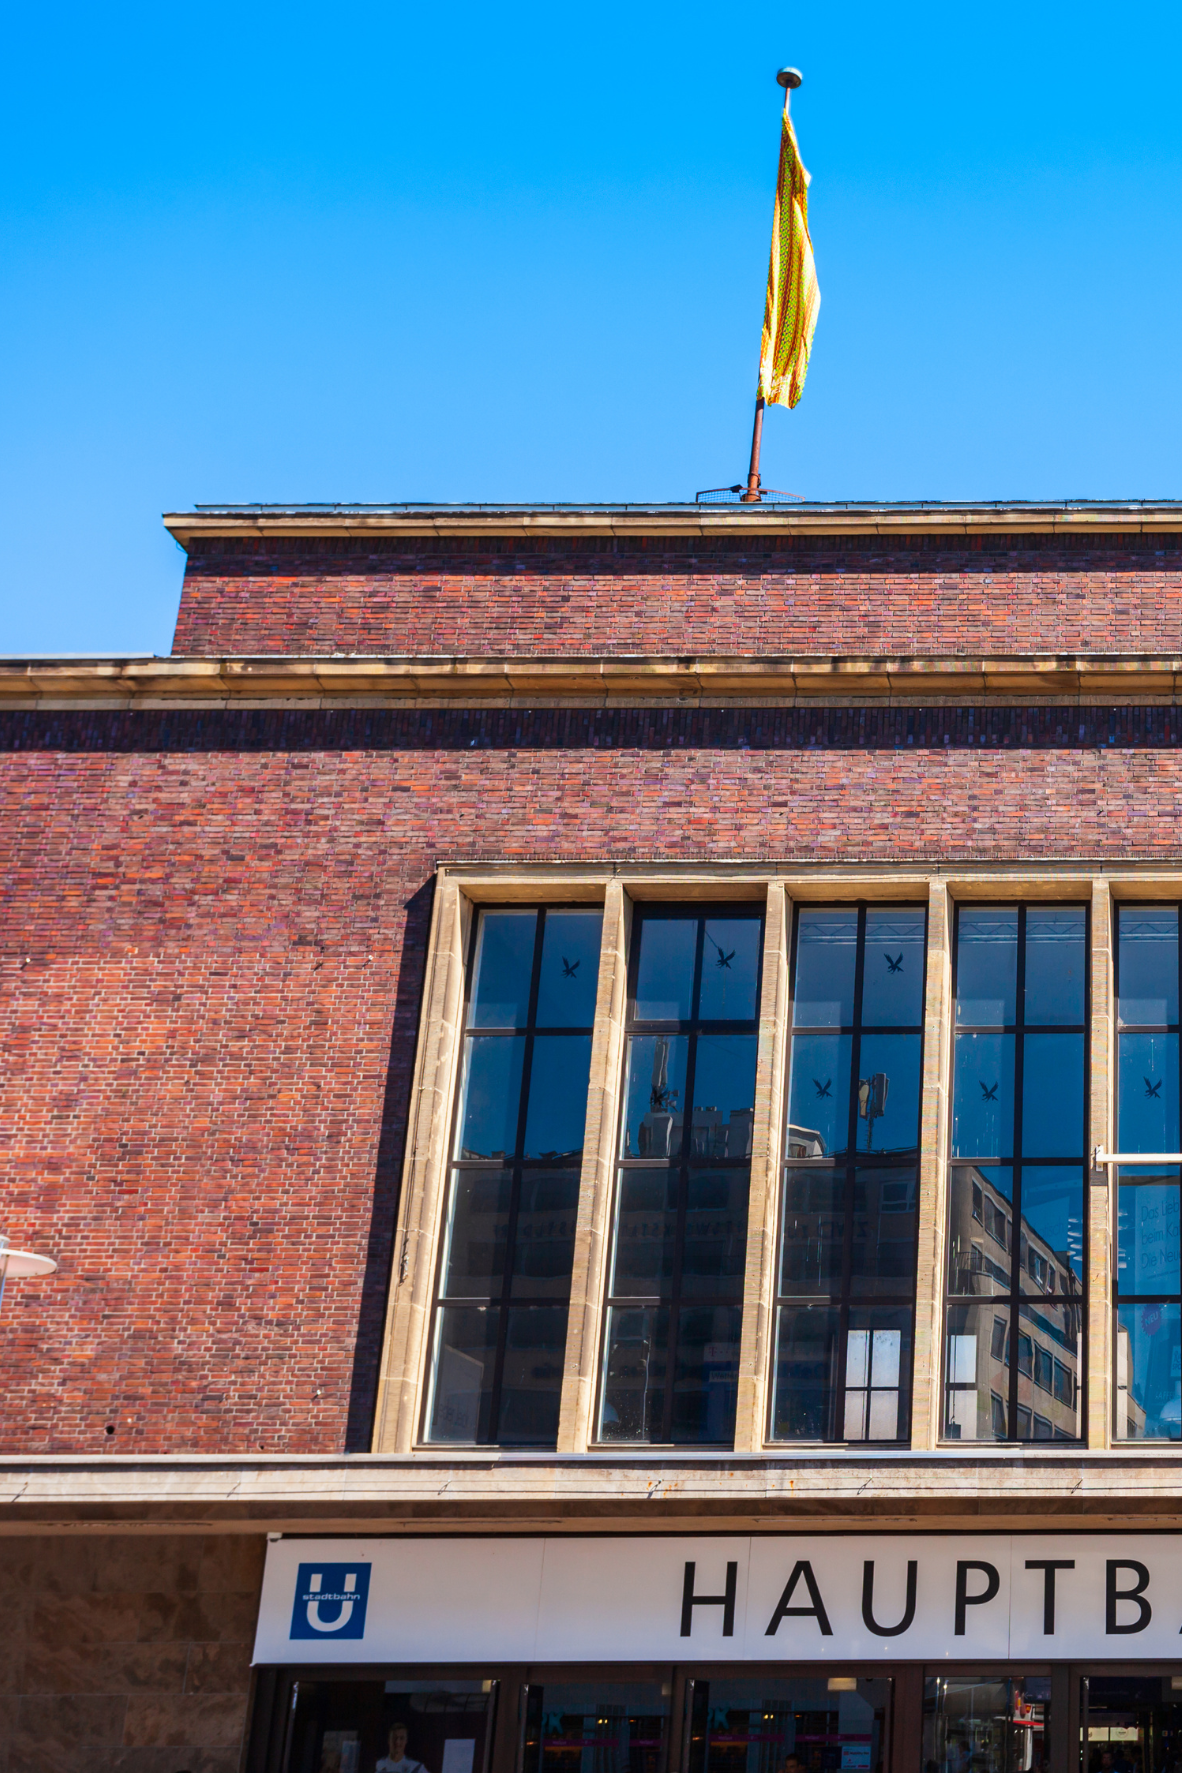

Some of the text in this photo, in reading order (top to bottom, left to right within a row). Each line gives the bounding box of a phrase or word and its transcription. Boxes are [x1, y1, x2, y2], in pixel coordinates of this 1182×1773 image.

[1141, 1205, 1159, 1222] Das
[1141, 1228, 1164, 1246] beim
[1141, 1252, 1157, 1269] Die
[1144, 1311, 1159, 1326] NEU
[306, 1573, 357, 1632] U
